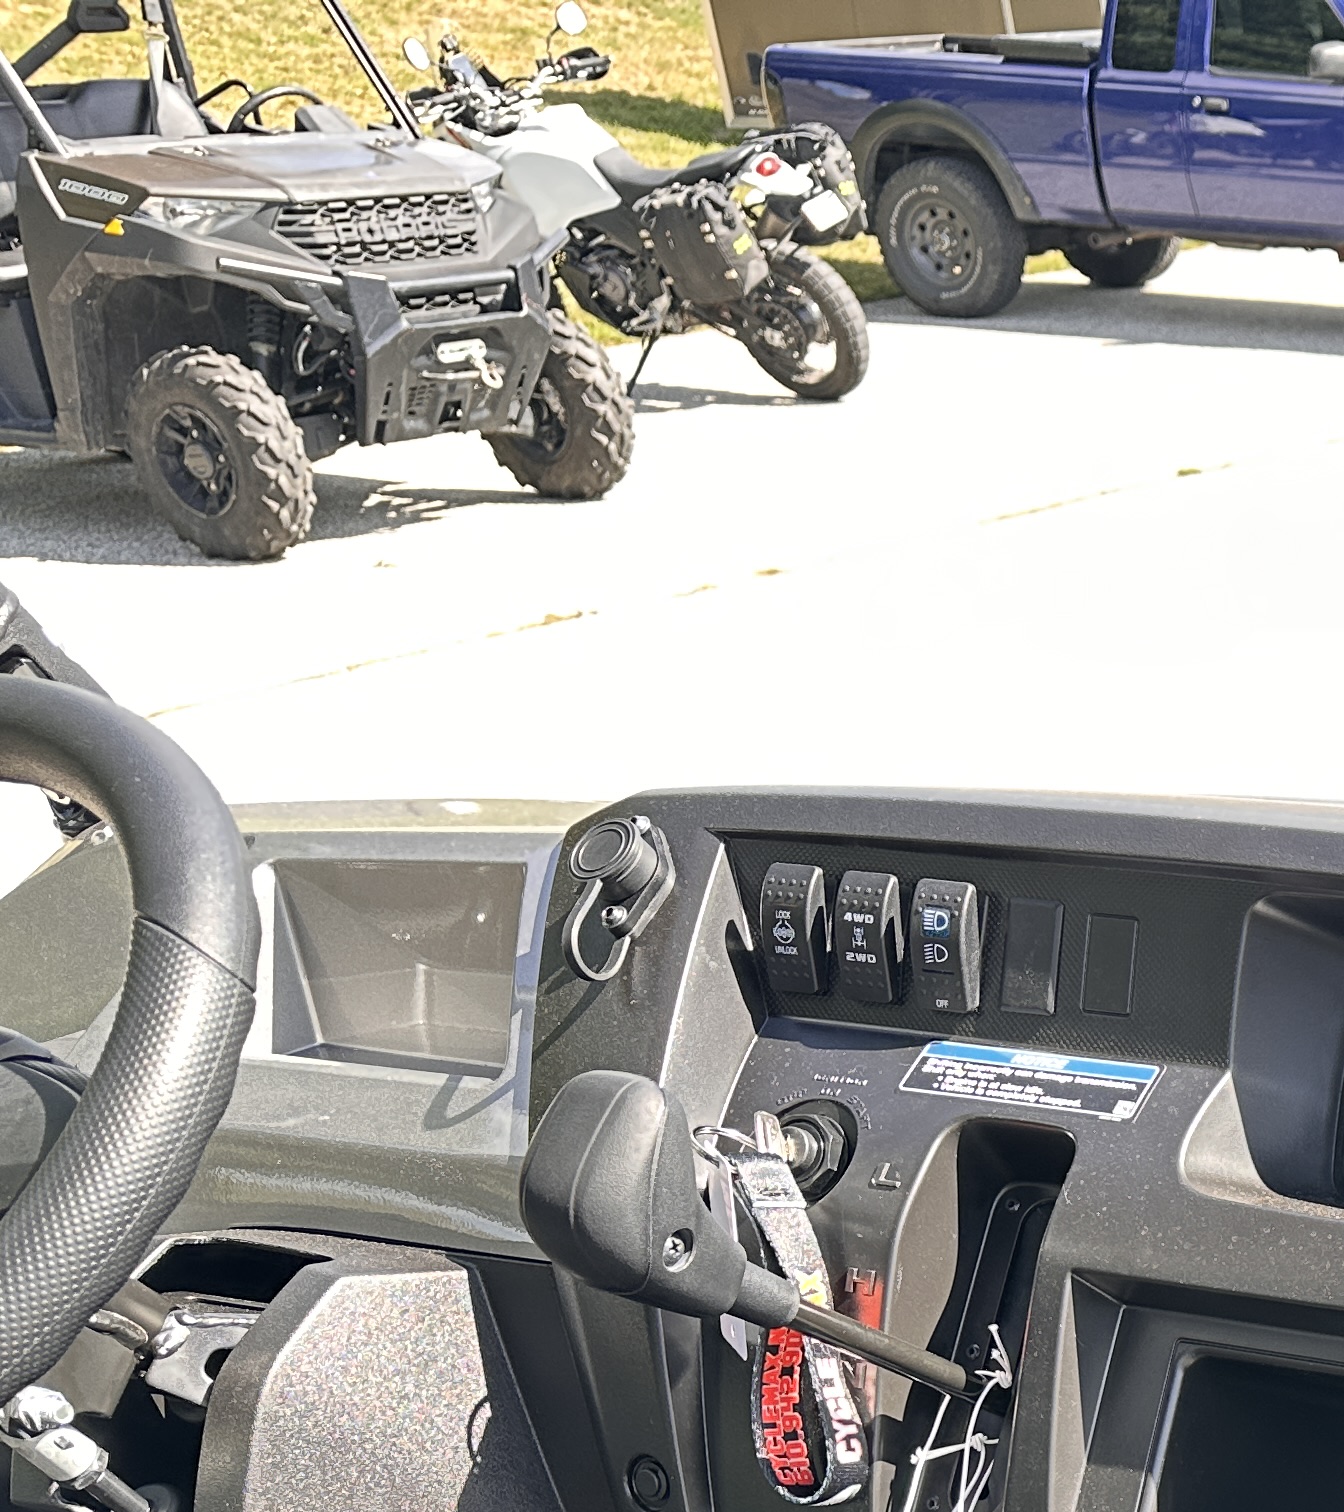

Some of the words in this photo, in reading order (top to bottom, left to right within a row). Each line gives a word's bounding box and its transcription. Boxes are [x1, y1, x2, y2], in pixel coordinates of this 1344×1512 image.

[58, 178, 129, 205] 1000
[775, 910, 791, 920] LOCK
[843, 912, 874, 924] 4WD
[774, 945, 798, 956] UNLOCK
[845, 951, 877, 964] 2WD
[935, 998, 949, 1008] OFF
[845, 1267, 876, 1296] H
